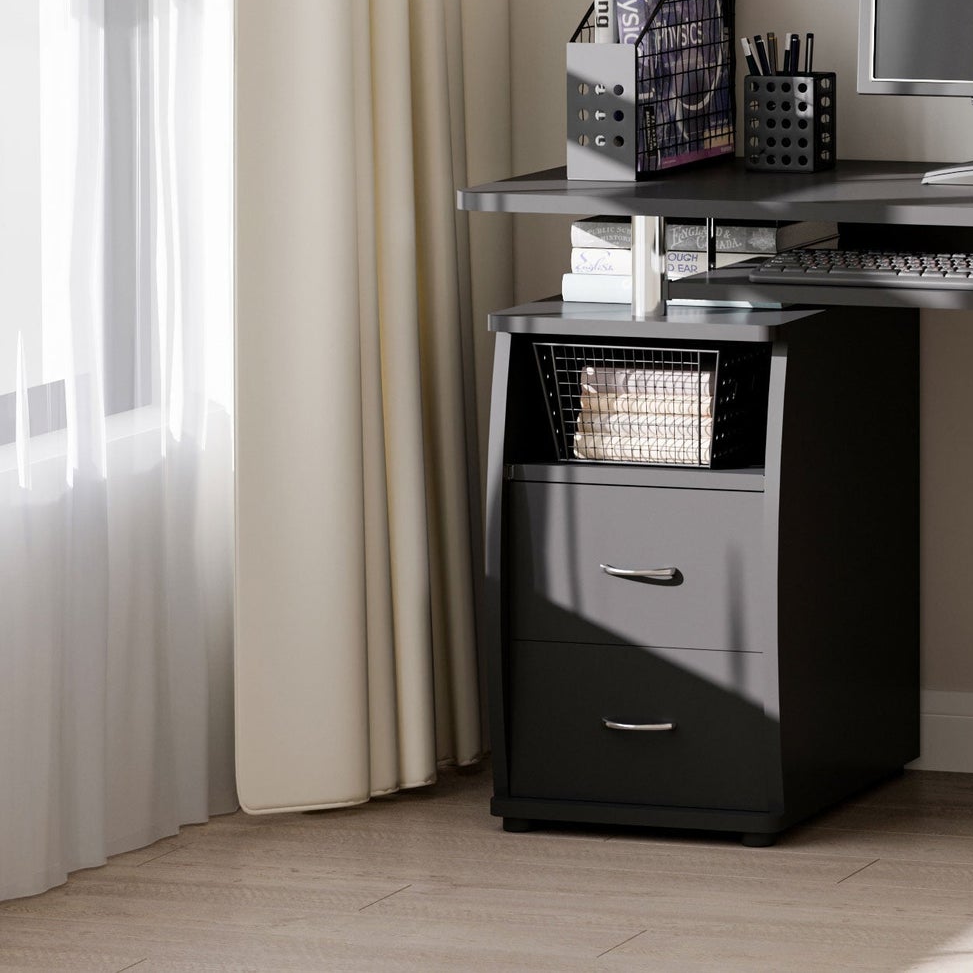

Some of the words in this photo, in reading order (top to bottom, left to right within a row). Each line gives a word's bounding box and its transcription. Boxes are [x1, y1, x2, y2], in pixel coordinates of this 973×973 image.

[654, 17, 702, 50] Physics
[588, 226, 615, 235] PUBLIC
[616, 226, 632, 234] SCH
[668, 226, 723, 249] ENGLAD
[723, 230, 732, 239] &
[696, 235, 742, 249] CADA.
[668, 252, 699, 262] OUGH
[678, 264, 698, 273] EAR
